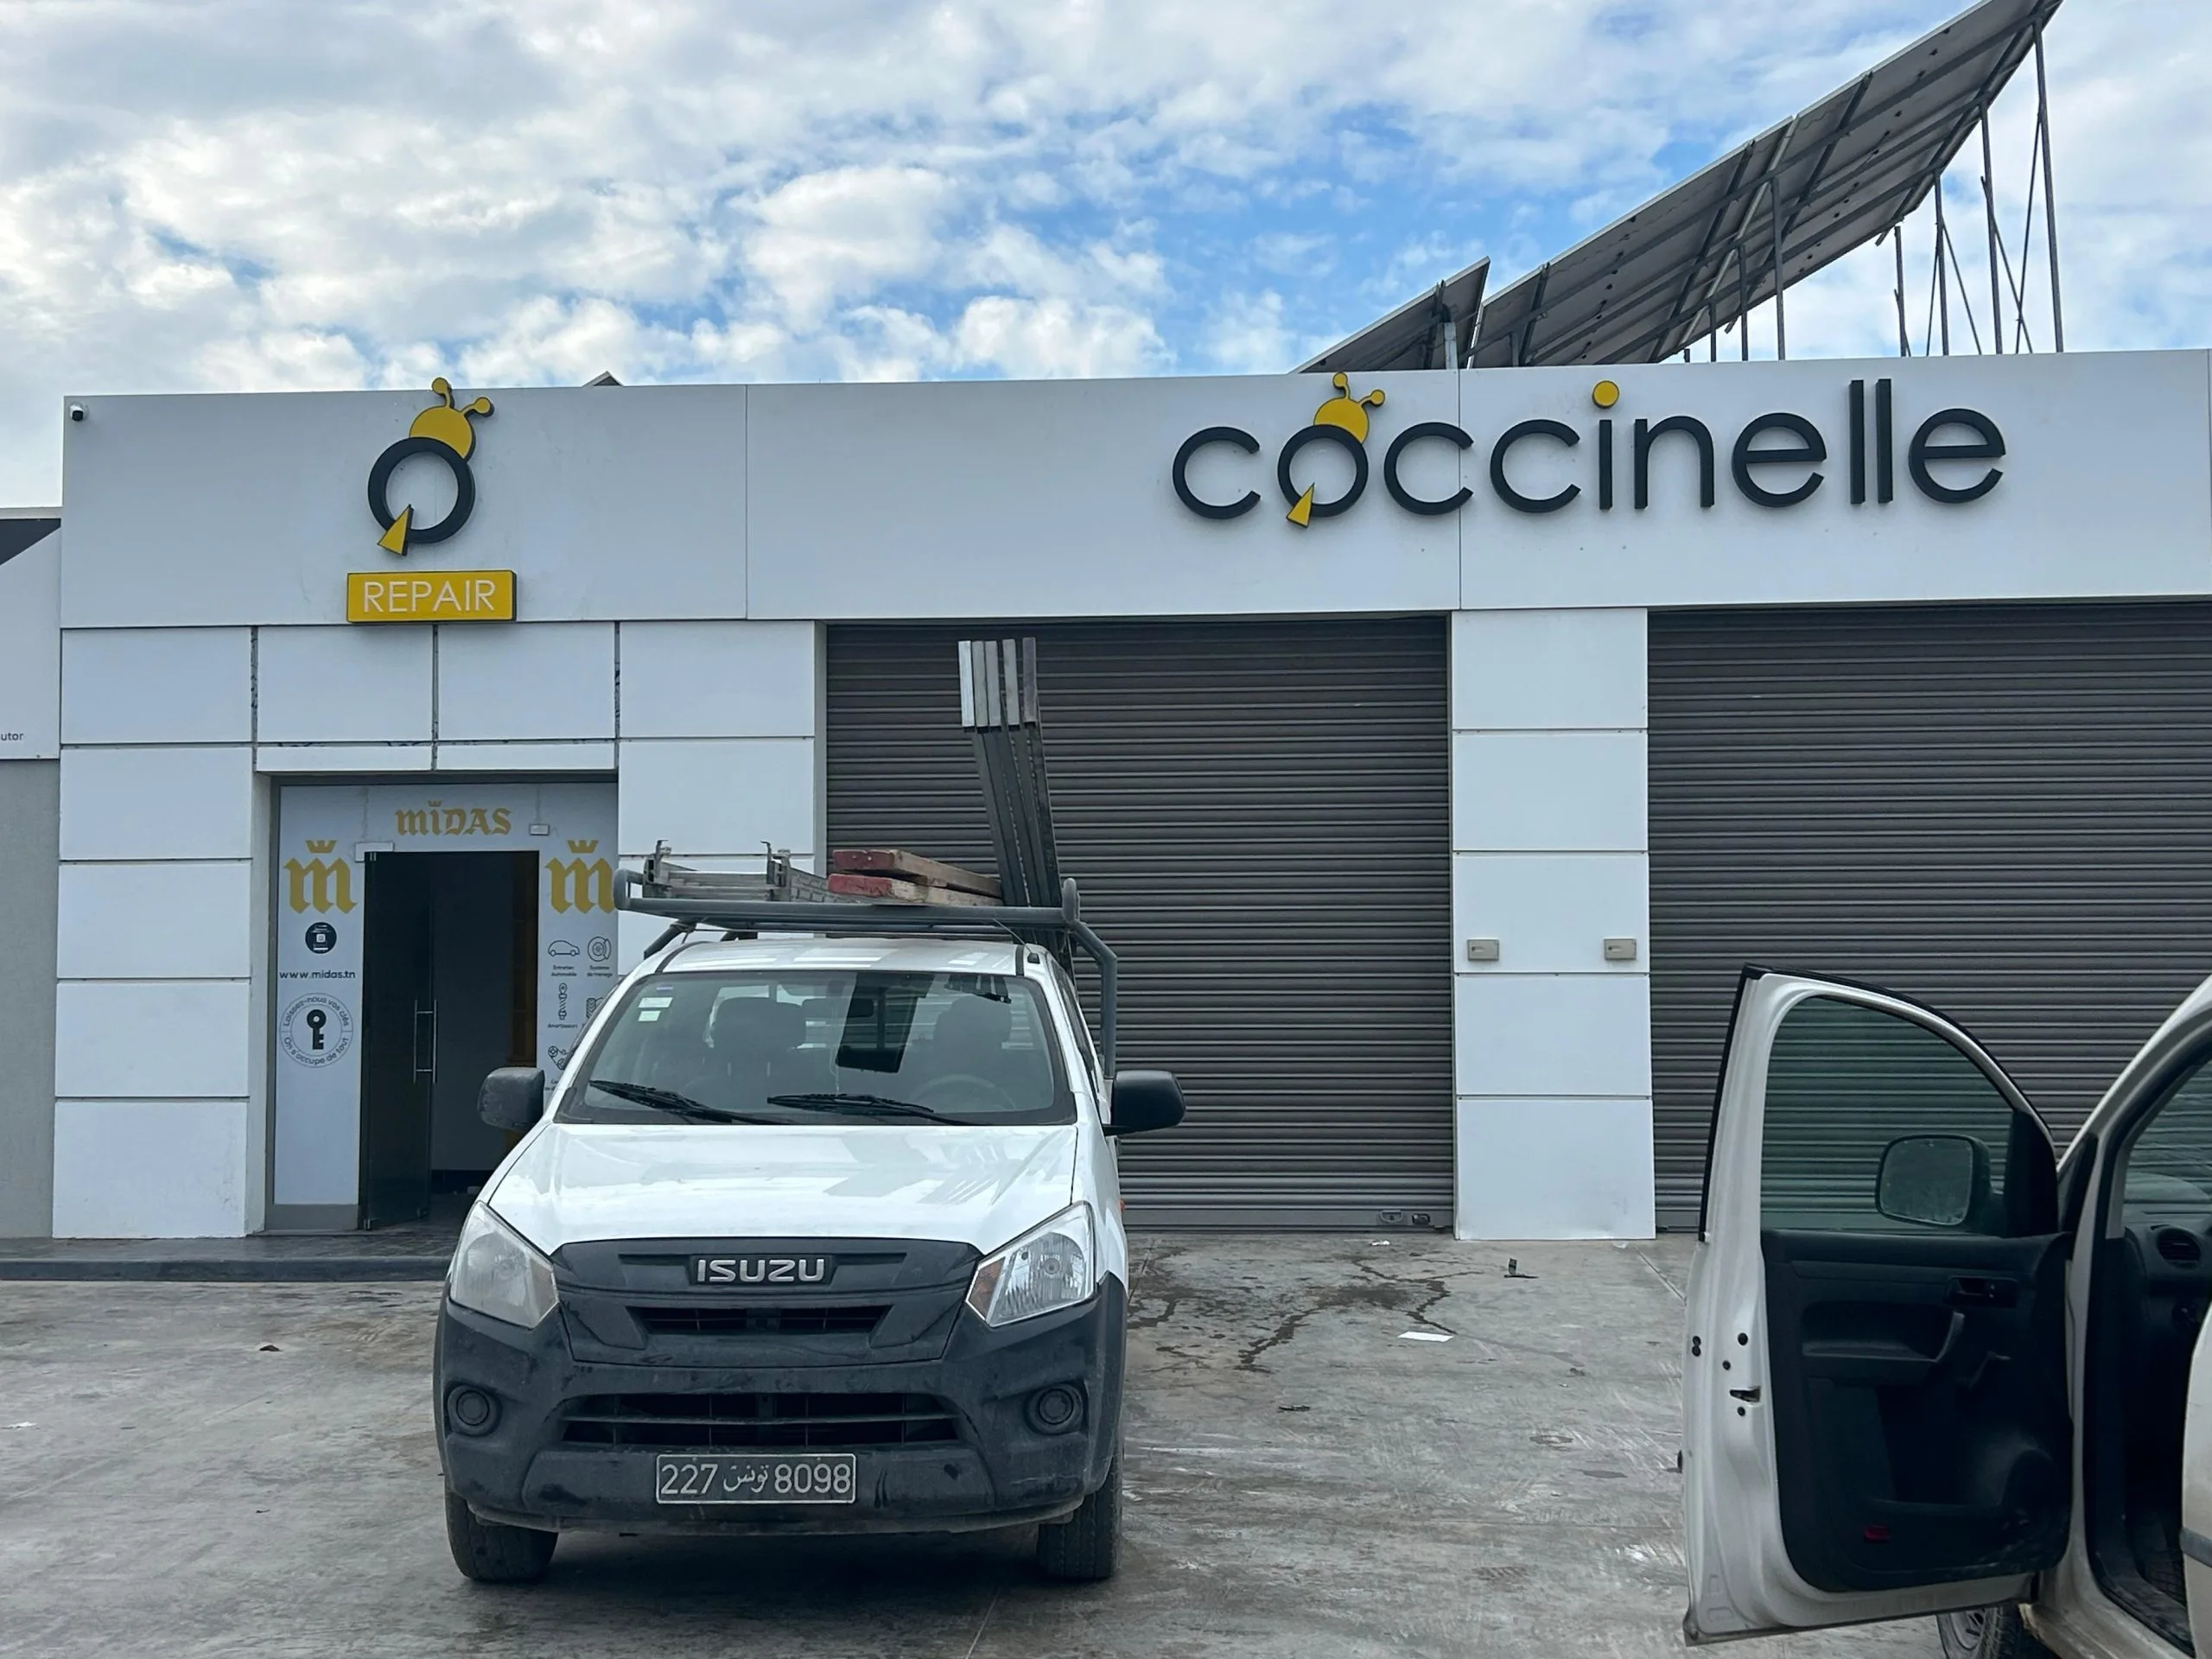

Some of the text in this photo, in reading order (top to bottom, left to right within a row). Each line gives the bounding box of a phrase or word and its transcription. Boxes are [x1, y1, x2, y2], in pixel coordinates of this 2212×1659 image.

[1173, 377, 2006, 526] coccinelle
[364, 580, 497, 613] REPAIR
[278, 969, 356, 979] www.midas.tn
[327, 1052, 337, 1062] de
[696, 1259, 825, 1282] ISUZU
[660, 1463, 851, 1494] 227 تونس 8098
